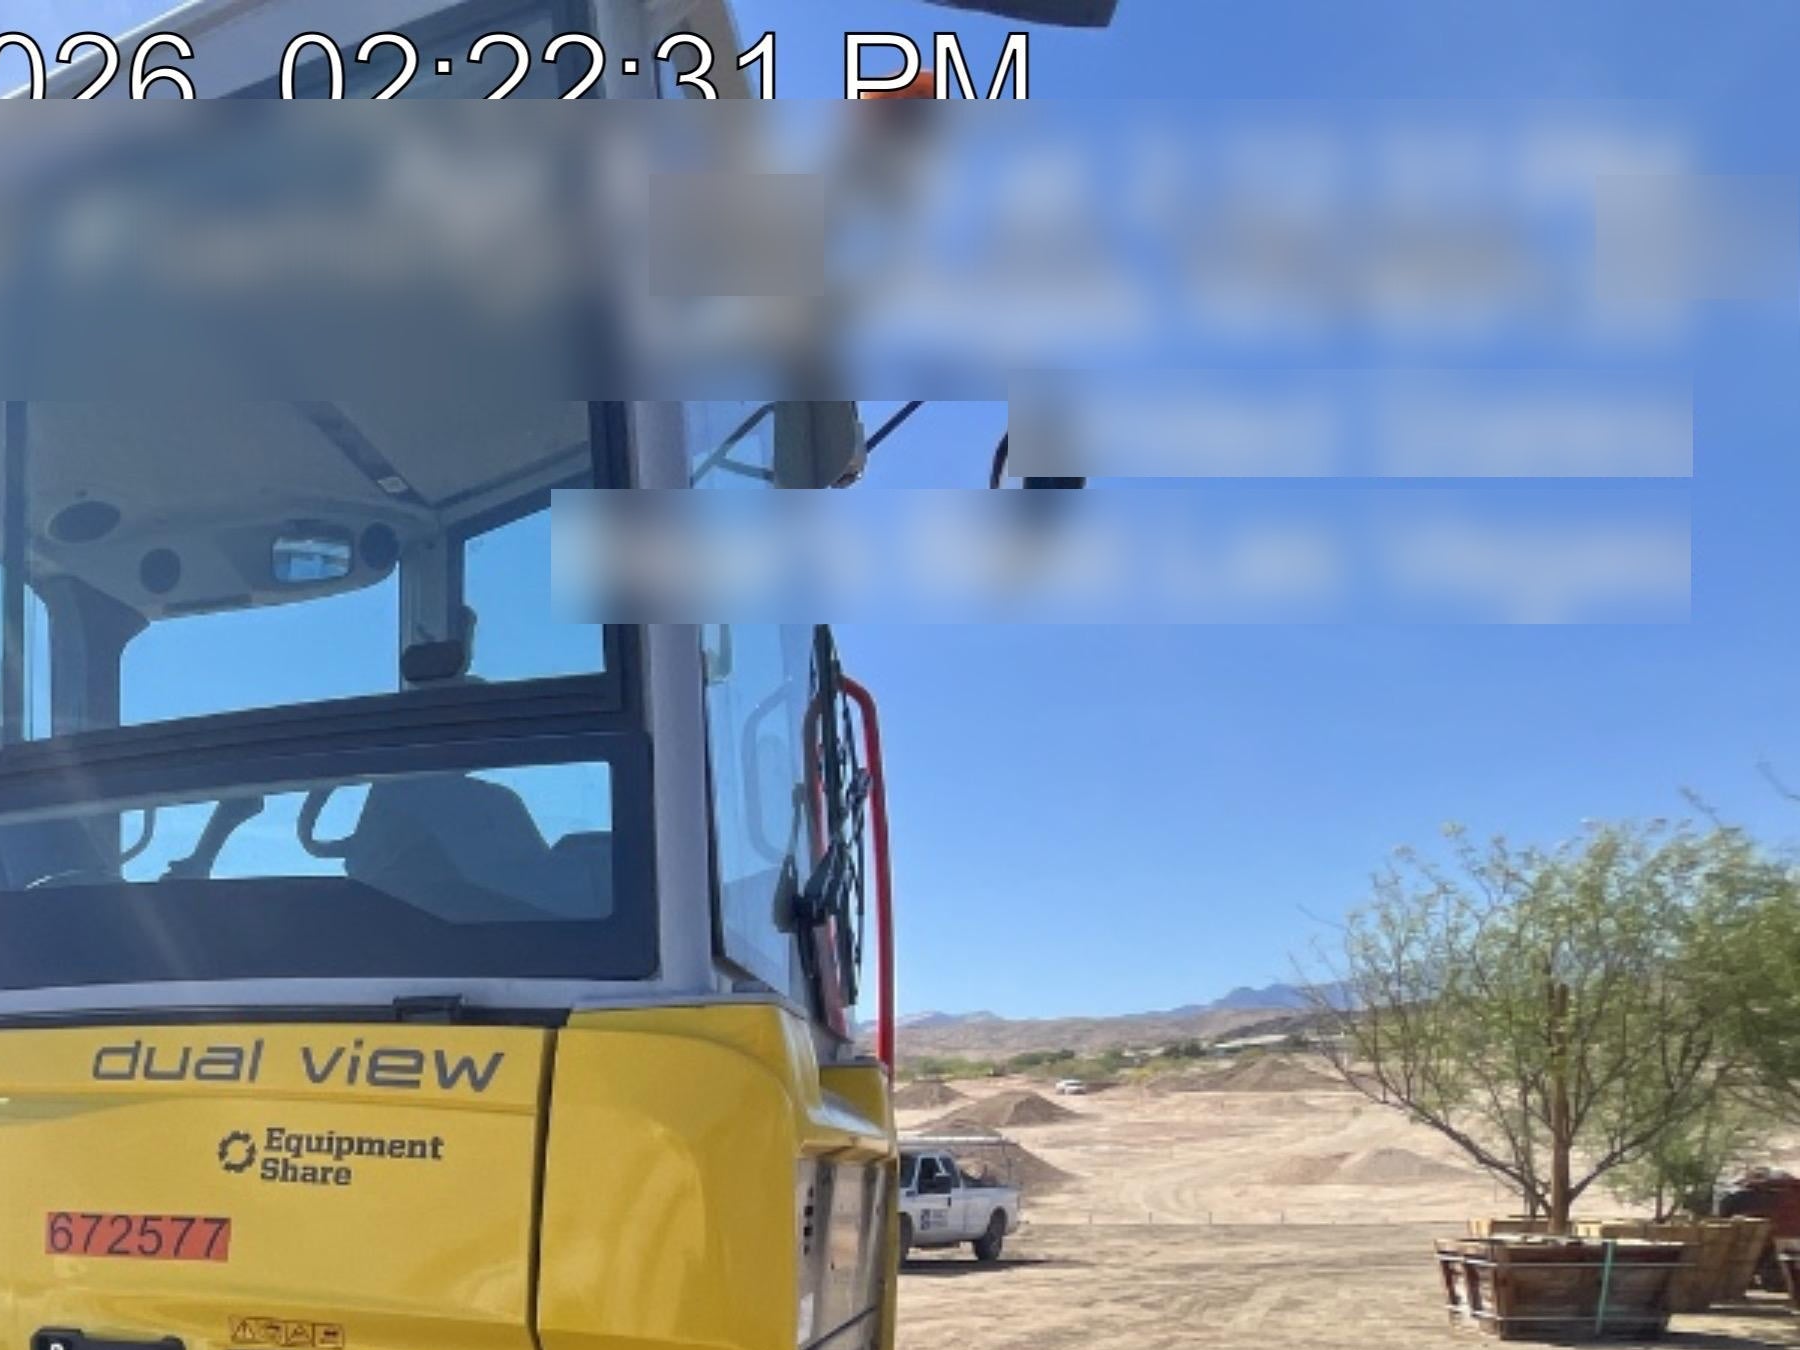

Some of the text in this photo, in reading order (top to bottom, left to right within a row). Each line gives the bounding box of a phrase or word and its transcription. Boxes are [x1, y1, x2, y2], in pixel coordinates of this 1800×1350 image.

[93, 1038, 505, 1093] dual view
[264, 1127, 445, 1161] Equipment
[260, 1157, 353, 1186] Share
[48, 1212, 230, 1259] 672577
